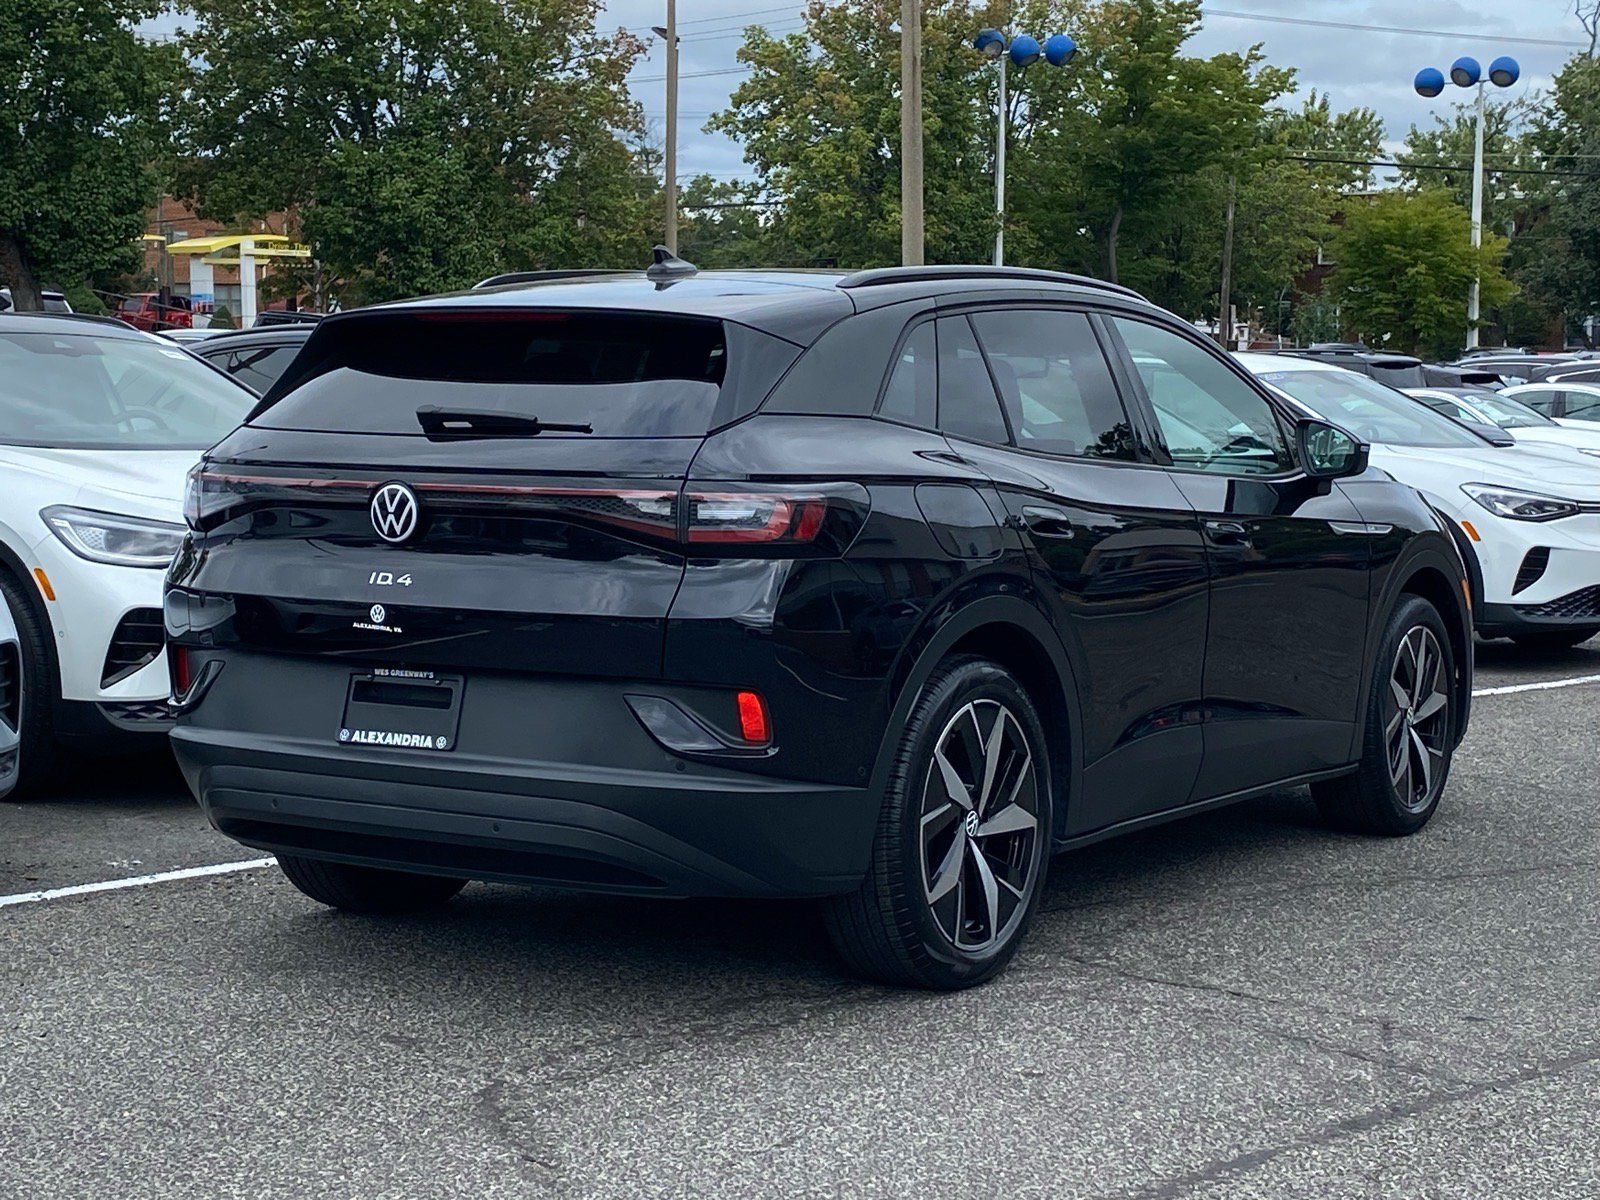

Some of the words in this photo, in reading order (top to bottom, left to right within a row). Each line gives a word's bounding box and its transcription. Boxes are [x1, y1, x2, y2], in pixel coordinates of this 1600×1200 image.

[374, 668, 389, 676] WES
[390, 669, 434, 679] GREENWAY'S
[350, 730, 433, 748] ALEXANDRIA
